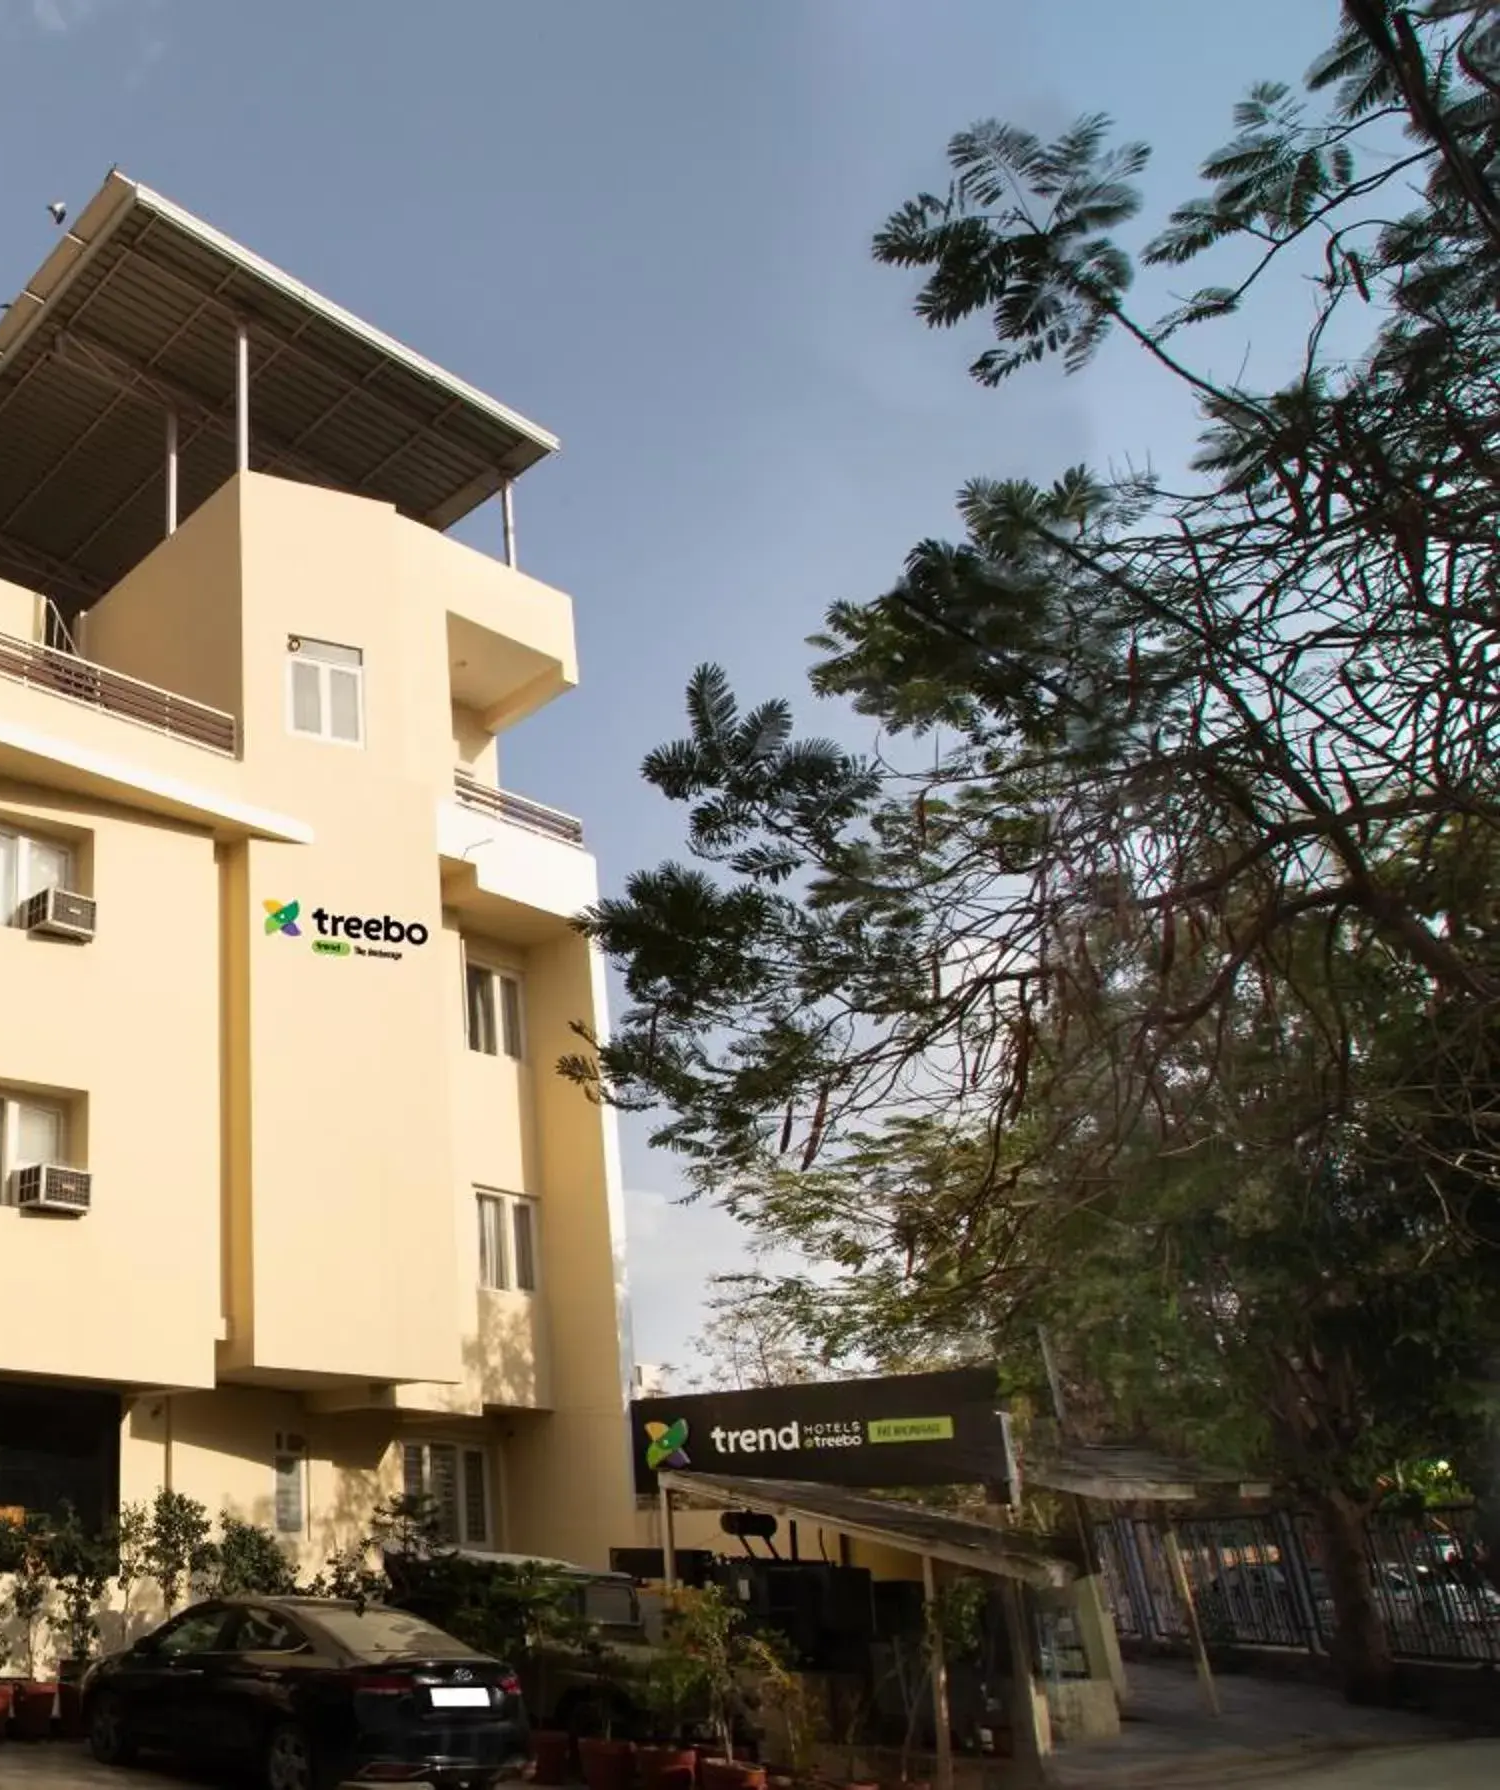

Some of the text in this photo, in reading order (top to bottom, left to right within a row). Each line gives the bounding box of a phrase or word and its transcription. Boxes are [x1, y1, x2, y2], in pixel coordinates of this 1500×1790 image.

[311, 908, 428, 945] treebo
[710, 1420, 800, 1453] trend
[803, 1421, 861, 1435] HOTELS
